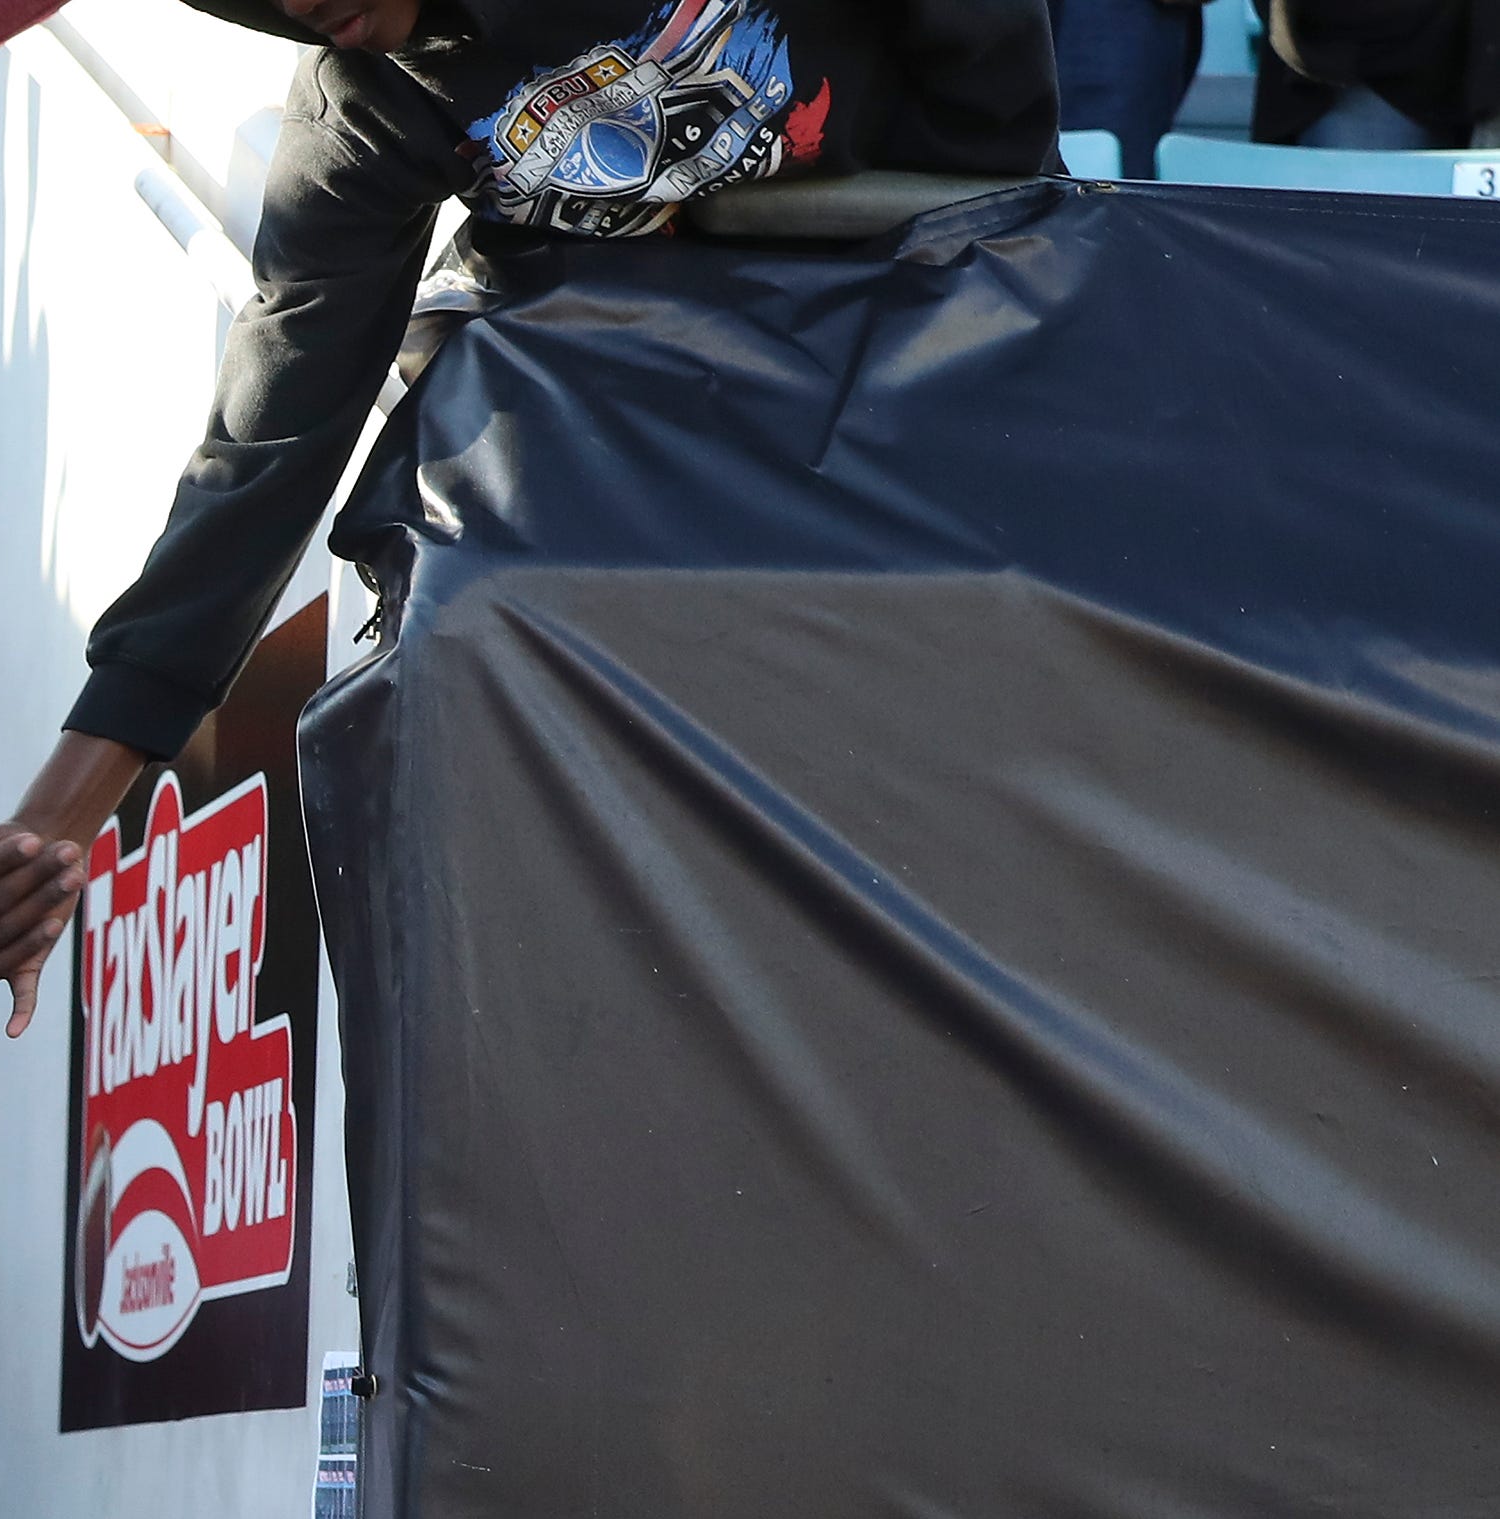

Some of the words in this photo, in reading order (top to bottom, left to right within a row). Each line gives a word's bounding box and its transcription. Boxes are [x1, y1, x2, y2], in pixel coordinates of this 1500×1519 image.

[532, 75, 590, 121] FBU
[667, 76, 787, 196] NAPLES
[88, 829, 262, 1138] TaxSlayer
[203, 1077, 287, 1237] BOWL
